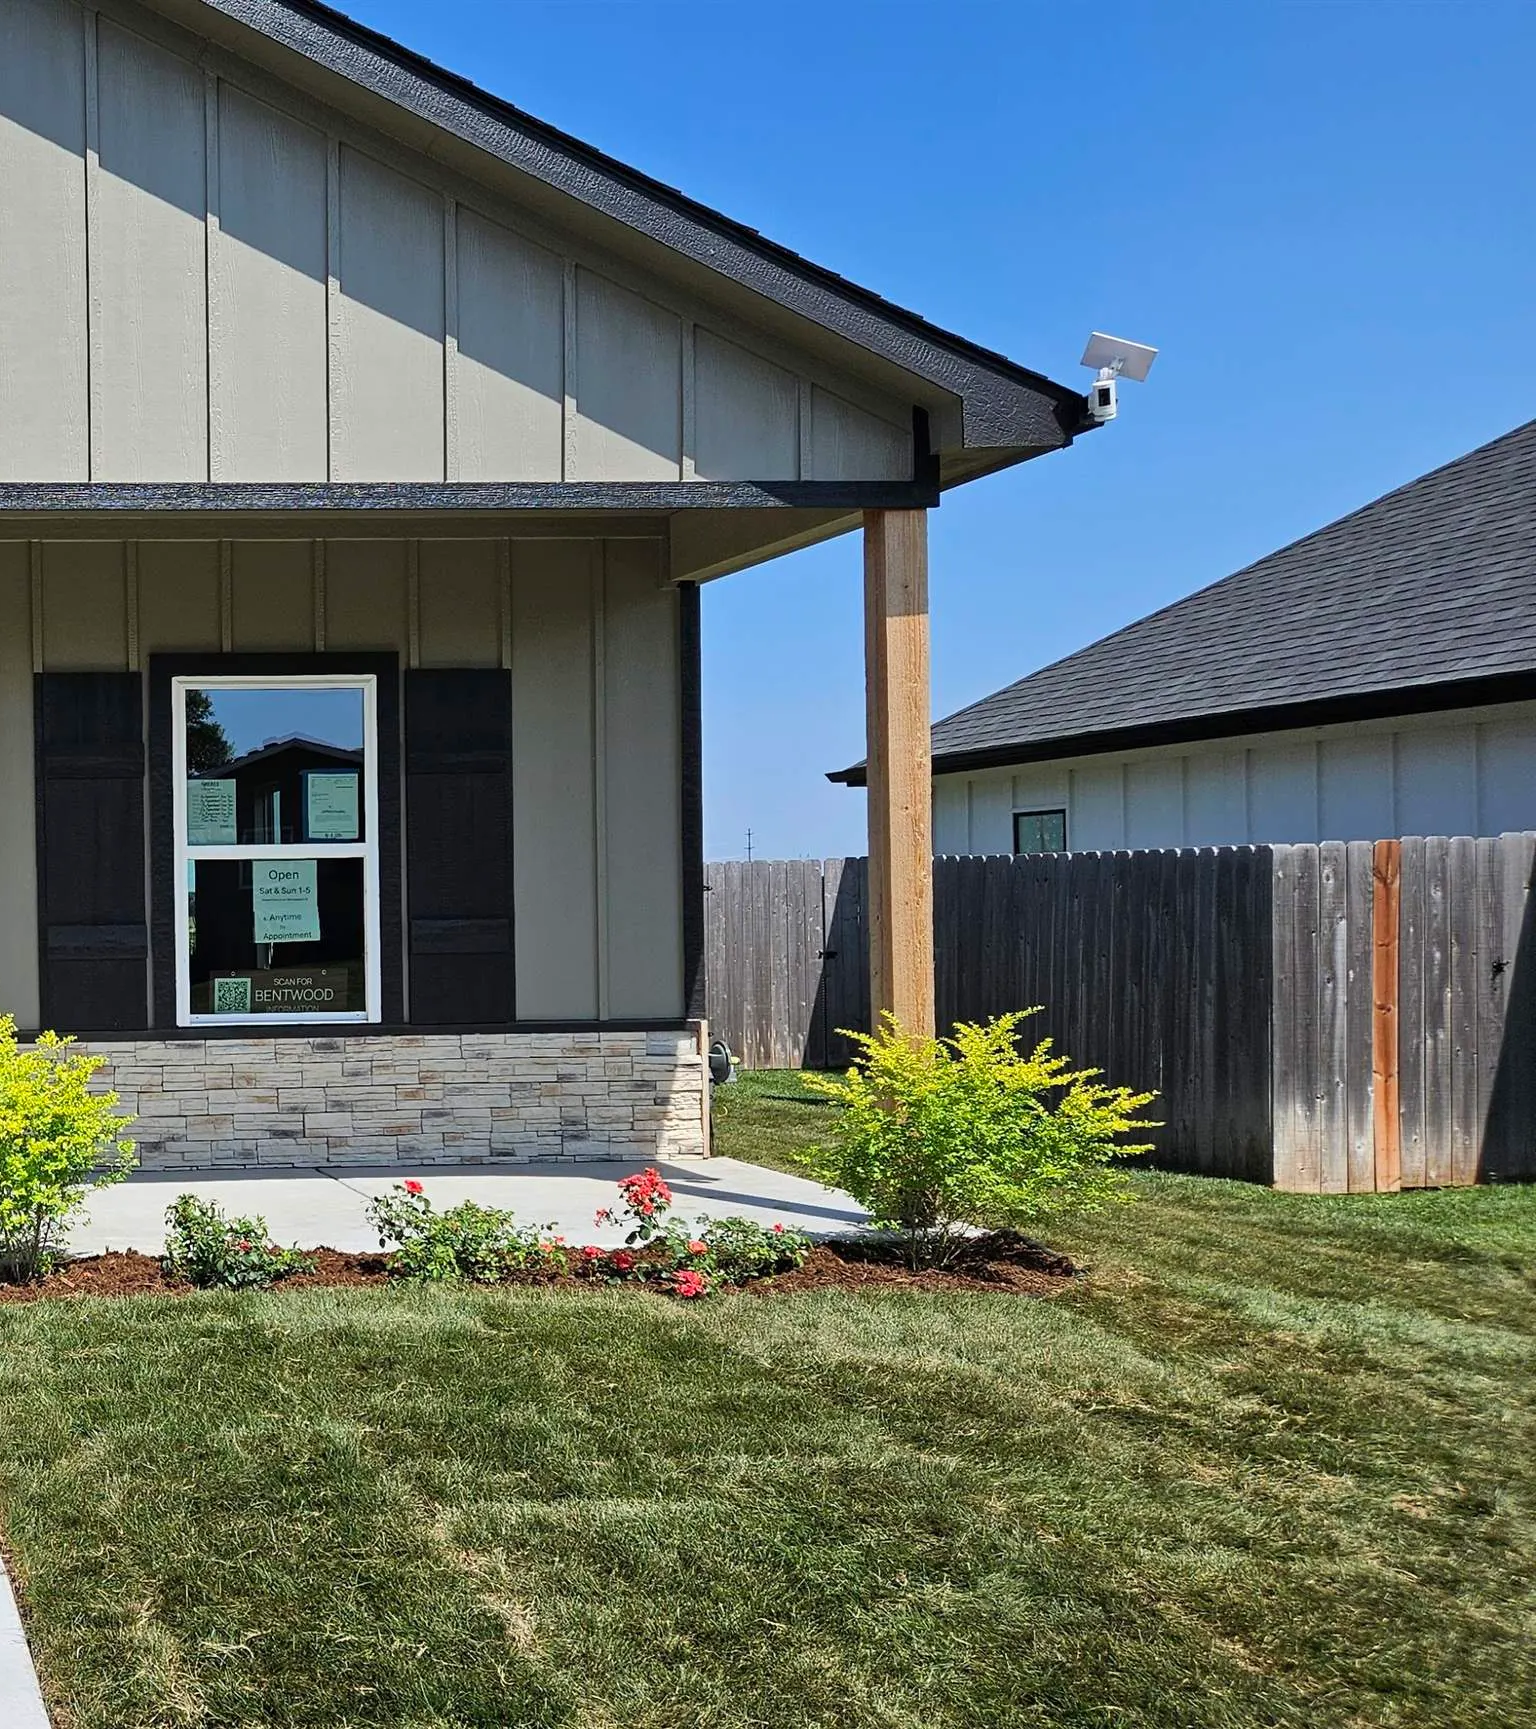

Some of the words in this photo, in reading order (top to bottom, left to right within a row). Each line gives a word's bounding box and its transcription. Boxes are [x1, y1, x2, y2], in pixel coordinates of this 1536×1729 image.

[268, 870, 300, 882] Open
[259, 887, 273, 895] Sat
[274, 887, 280, 895] &
[299, 886, 311, 894] 1-5
[269, 913, 302, 923] Anytime
[263, 931, 312, 941] Appointment
[273, 978, 296, 986] SCAN
[297, 977, 313, 985] FOR
[255, 988, 334, 1002] BENTWOOD
